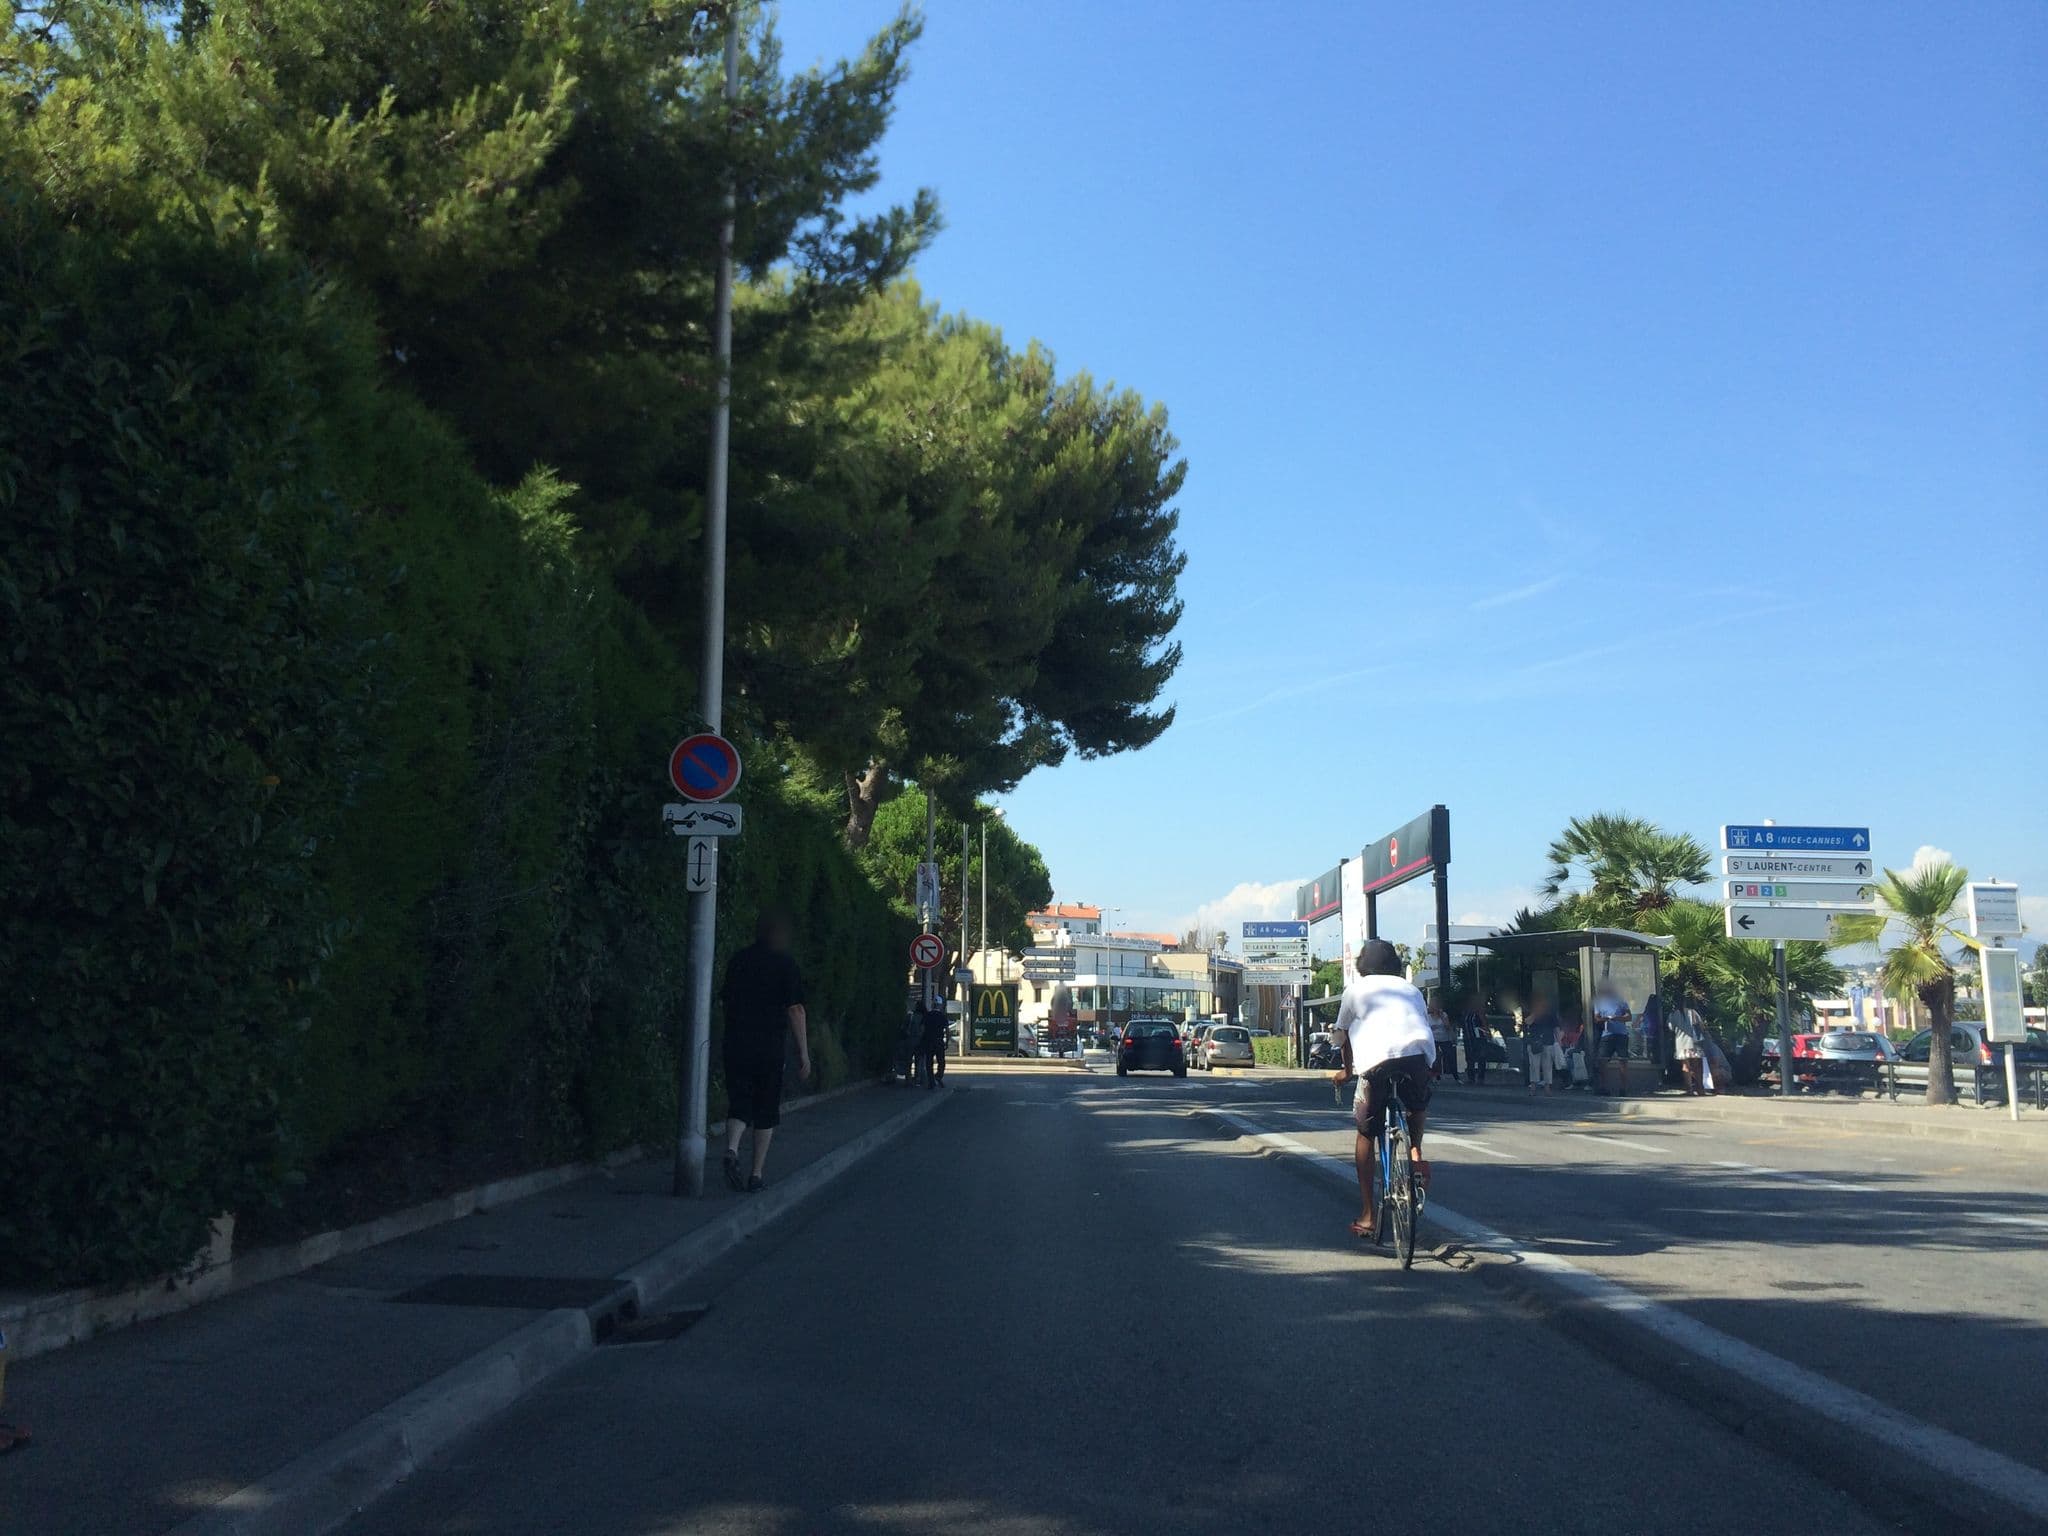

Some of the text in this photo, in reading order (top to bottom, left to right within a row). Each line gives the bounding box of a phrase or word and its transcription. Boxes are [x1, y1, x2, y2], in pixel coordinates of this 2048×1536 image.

[1754, 832, 1845, 845] A 8 (NICE-CANNES)
[1735, 885, 1744, 896] P
